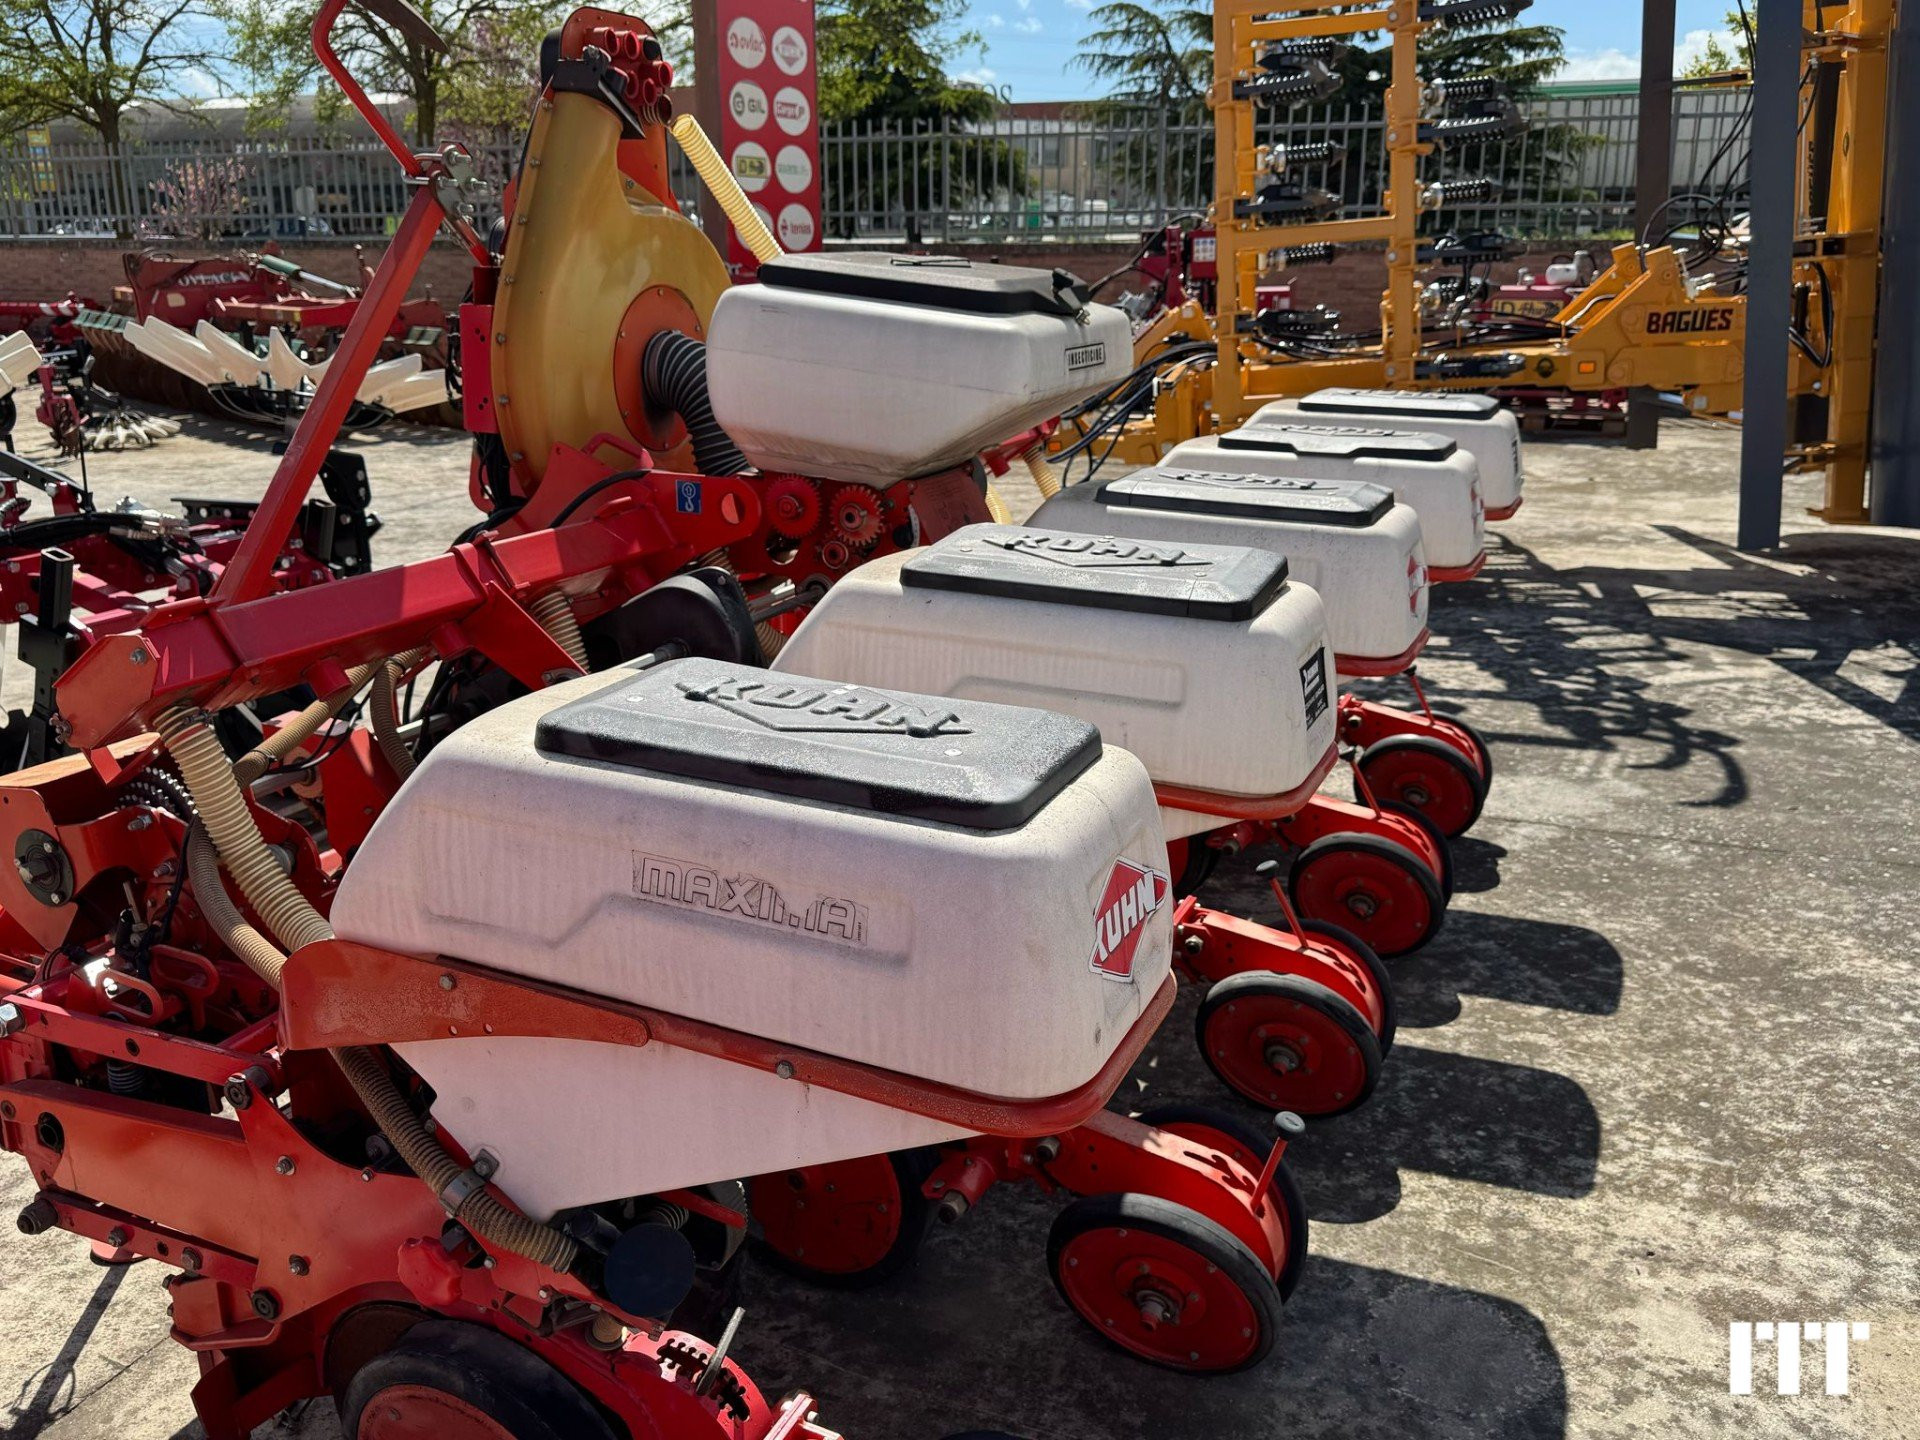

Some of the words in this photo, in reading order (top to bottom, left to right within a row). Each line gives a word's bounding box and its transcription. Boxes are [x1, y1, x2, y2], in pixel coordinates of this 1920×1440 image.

[1067, 347, 1102, 366] INSECTICIDE
[1003, 534, 1187, 567] KUHN
[682, 675, 960, 738] KUHN
[1096, 870, 1157, 962] KUHN
